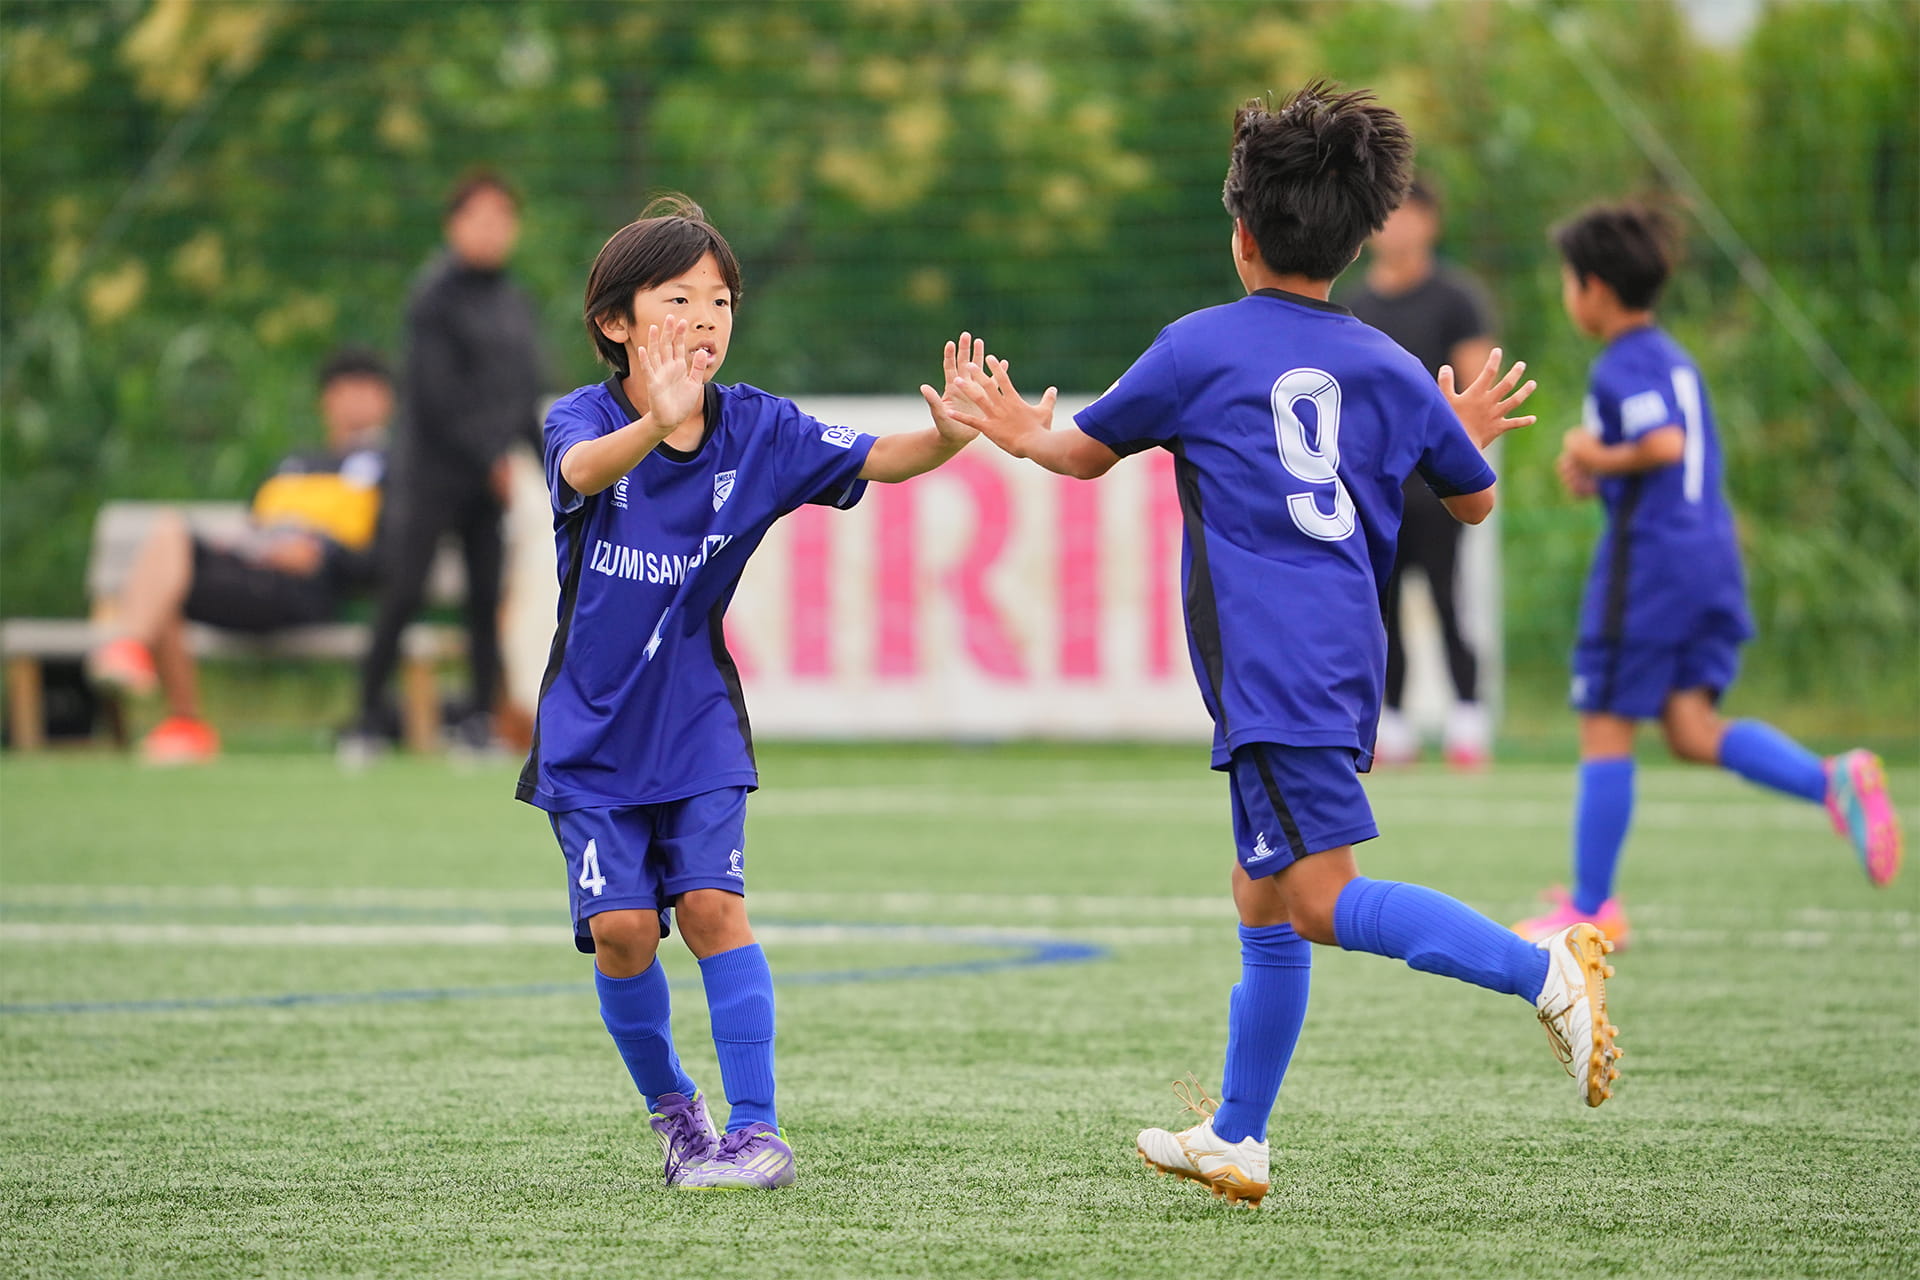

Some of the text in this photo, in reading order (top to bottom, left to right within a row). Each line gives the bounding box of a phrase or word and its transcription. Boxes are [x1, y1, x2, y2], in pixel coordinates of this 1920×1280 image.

[1271, 367, 1355, 541] 9
[589, 539, 688, 586] IZUMISAN
[723, 449, 1183, 680] IRI
[579, 838, 607, 896] 4
